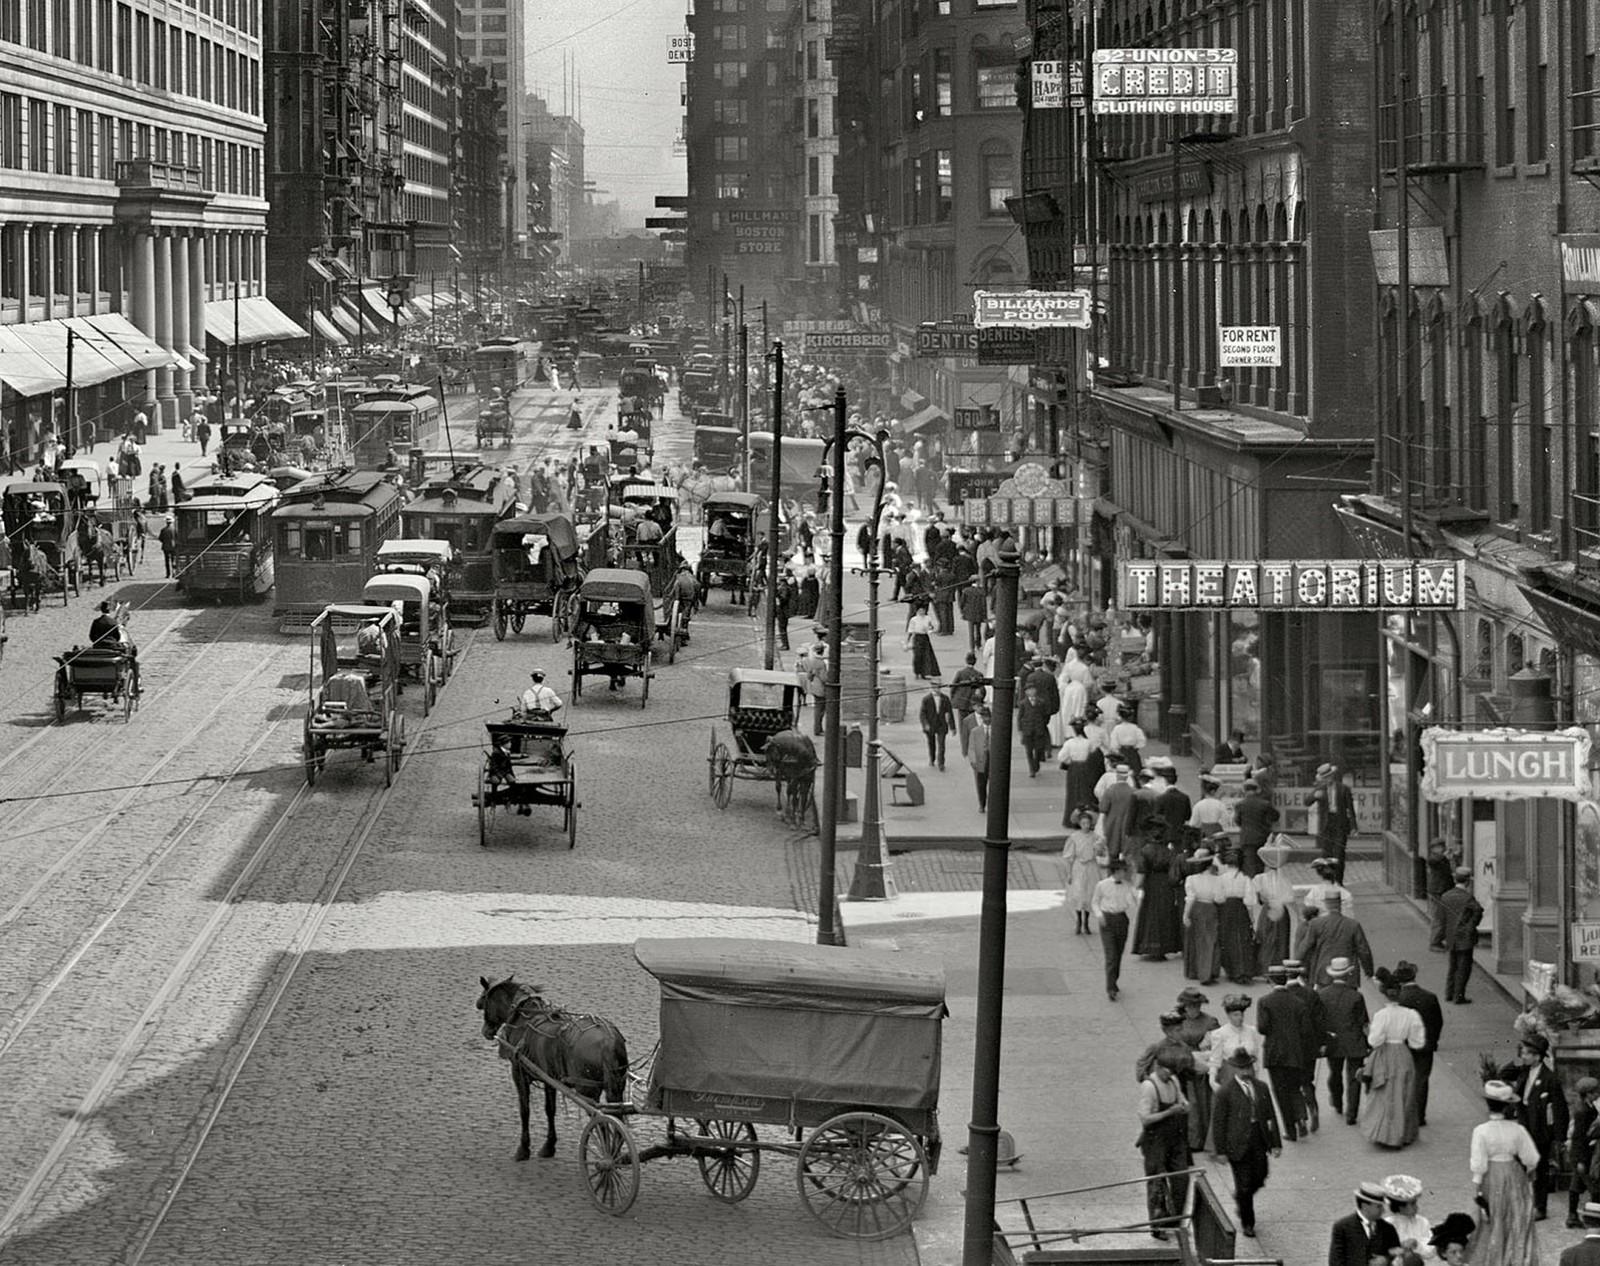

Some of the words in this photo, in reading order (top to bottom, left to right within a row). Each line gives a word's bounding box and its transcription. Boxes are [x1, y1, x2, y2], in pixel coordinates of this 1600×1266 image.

[671, 38, 692, 48] BOST
[1034, 63, 1053, 74] TO
[1056, 62, 1083, 74] REN
[1101, 68, 1230, 95] CREDIT
[1098, 101, 1176, 113] CLOTHING
[1180, 101, 1234, 113] HOUSE
[736, 226, 785, 237] BOSTON
[739, 242, 782, 252] STORE
[986, 299, 1081, 309] BILLIARDS
[1003, 311, 1062, 320] POOL
[805, 335, 890, 346] KIRCHBERG
[921, 333, 978, 349] DENTIS
[1222, 329, 1245, 342] FOR
[1246, 329, 1277, 342] RENT
[1223, 345, 1251, 353] SECOND
[1253, 345, 1276, 353] FLOOR
[955, 411, 997, 427] DRUS
[1130, 568, 1455, 605] THEATORIUM
